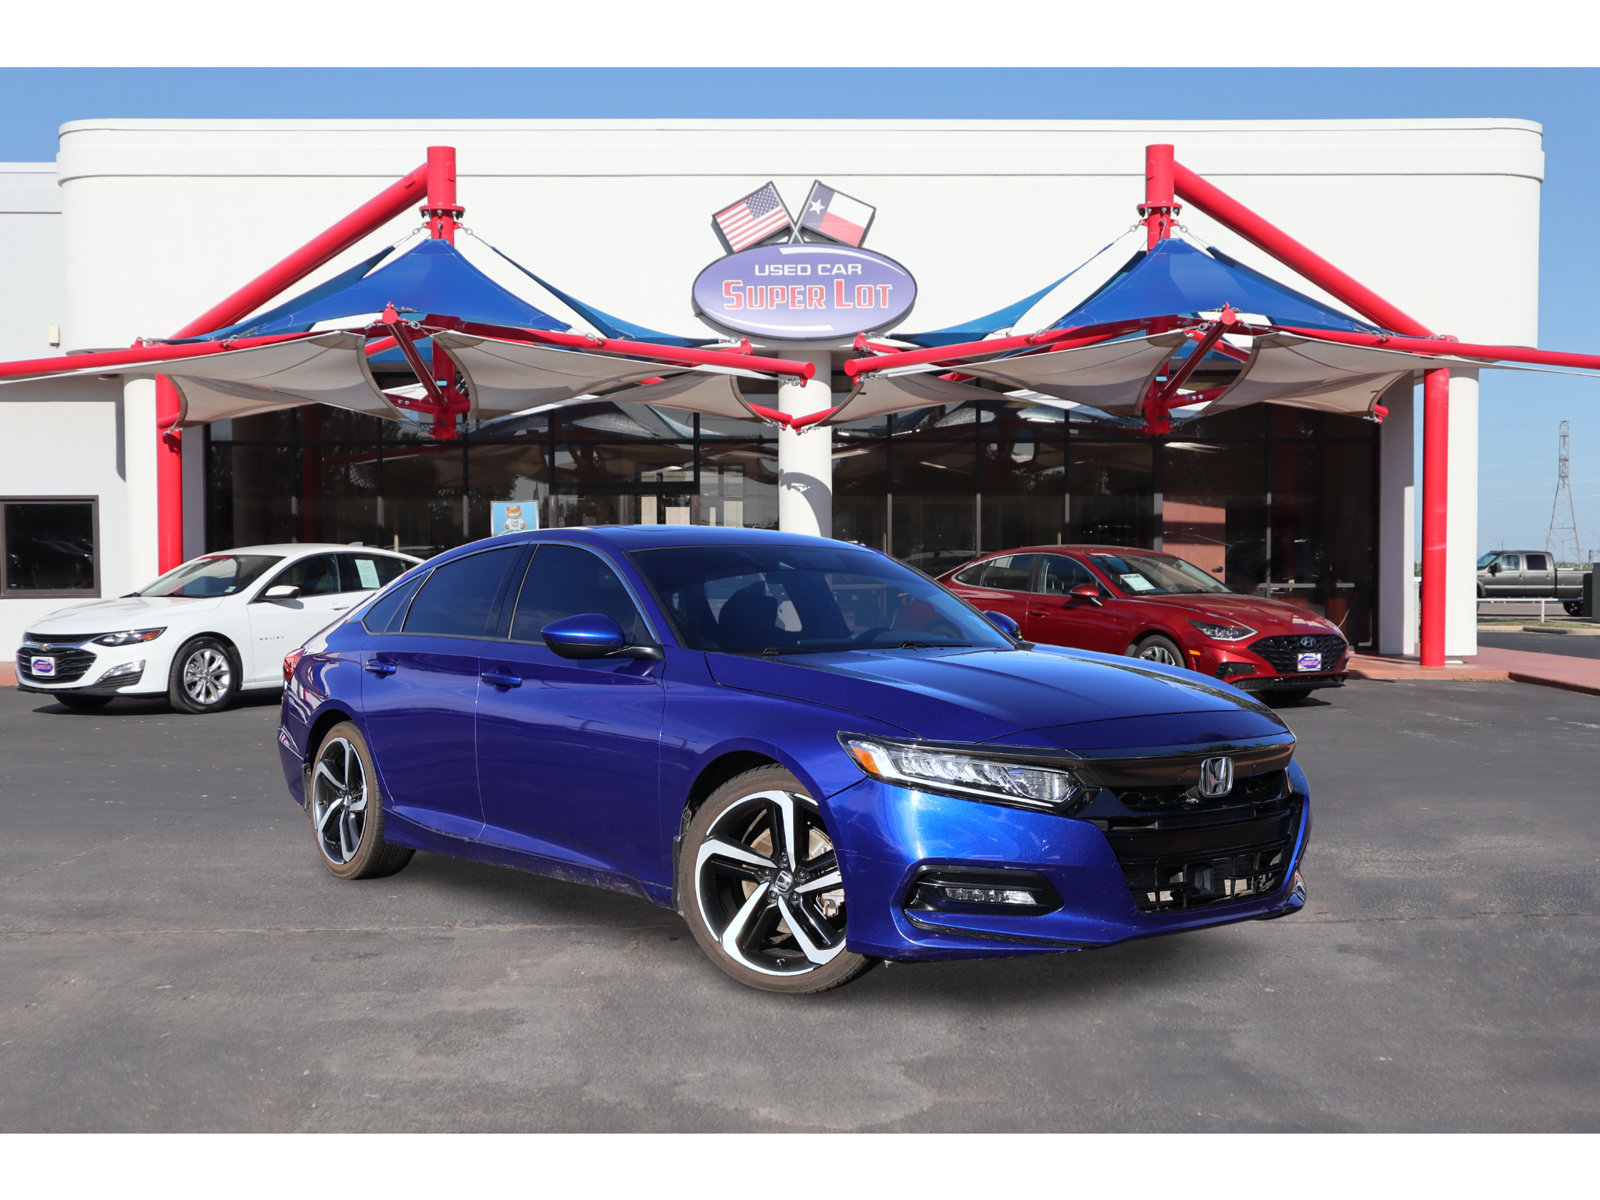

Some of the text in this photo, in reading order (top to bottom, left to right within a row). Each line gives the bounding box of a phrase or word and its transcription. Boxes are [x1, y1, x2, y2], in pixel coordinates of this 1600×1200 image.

[754, 263, 862, 276] USED CAR
[722, 279, 893, 310] SUPER LOT
